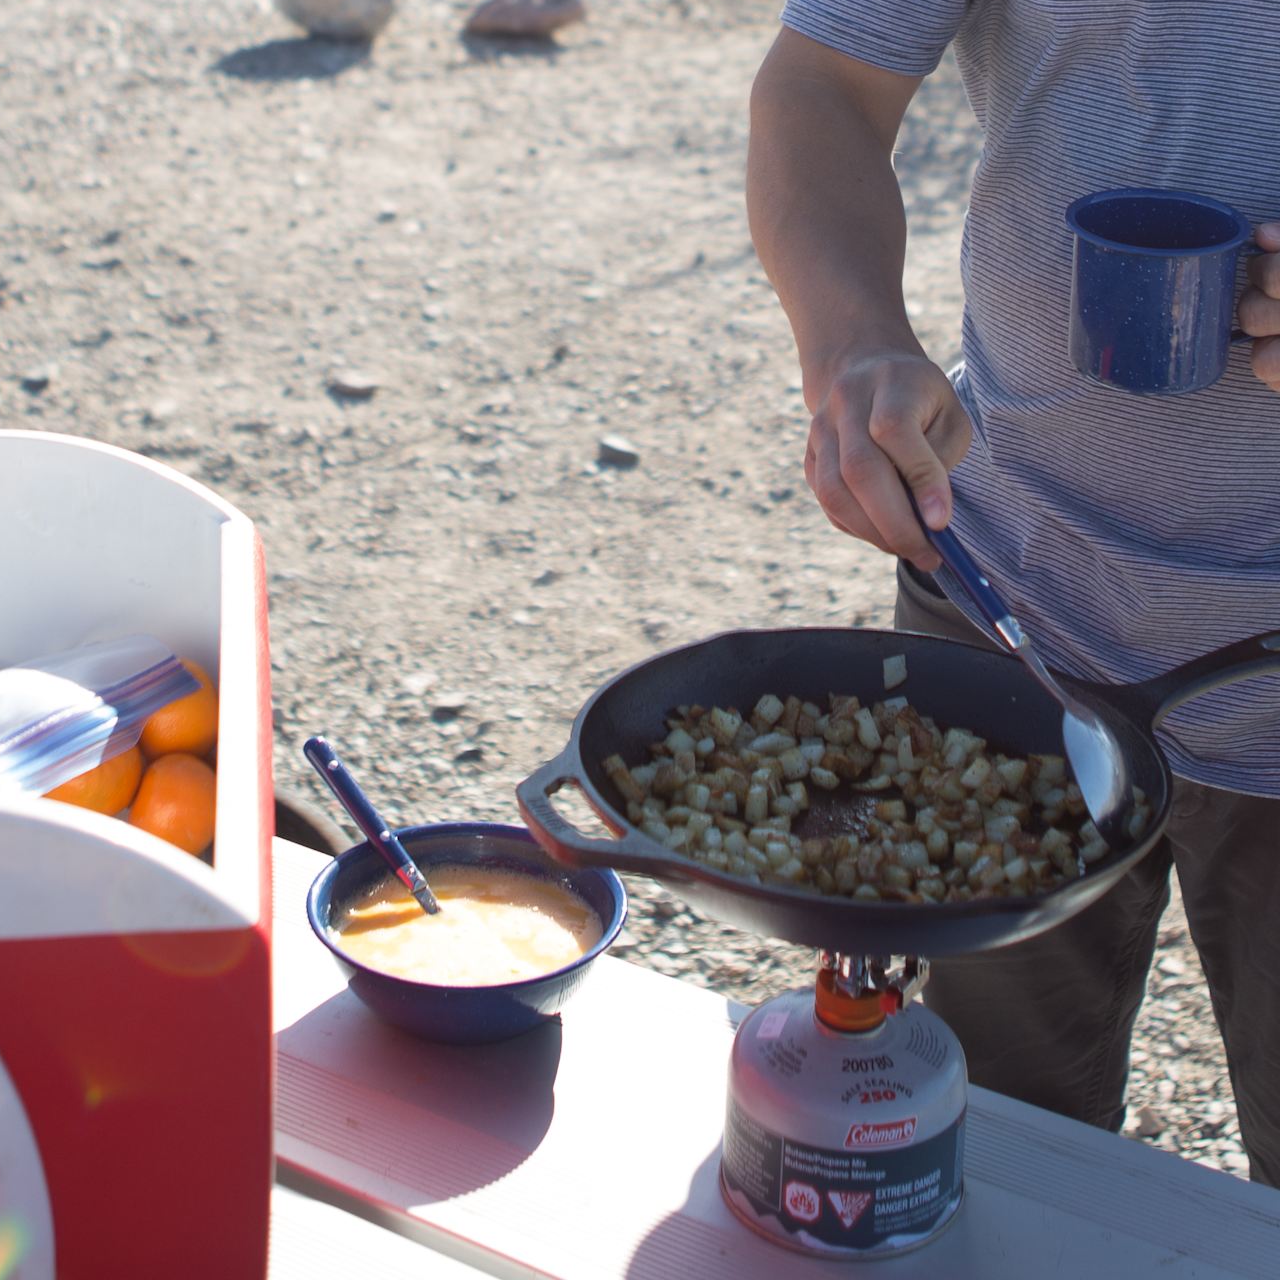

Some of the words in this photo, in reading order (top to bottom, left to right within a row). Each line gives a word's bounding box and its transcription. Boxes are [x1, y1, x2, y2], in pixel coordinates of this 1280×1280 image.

[864, 1078, 913, 1099] SEALING
[852, 1125, 903, 1144] Coleman
[851, 1158, 867, 1168] Mix
[875, 1182, 913, 1201] EXTREME
[913, 1168, 942, 1193] DANGER
[874, 1197, 909, 1216] DANGER
